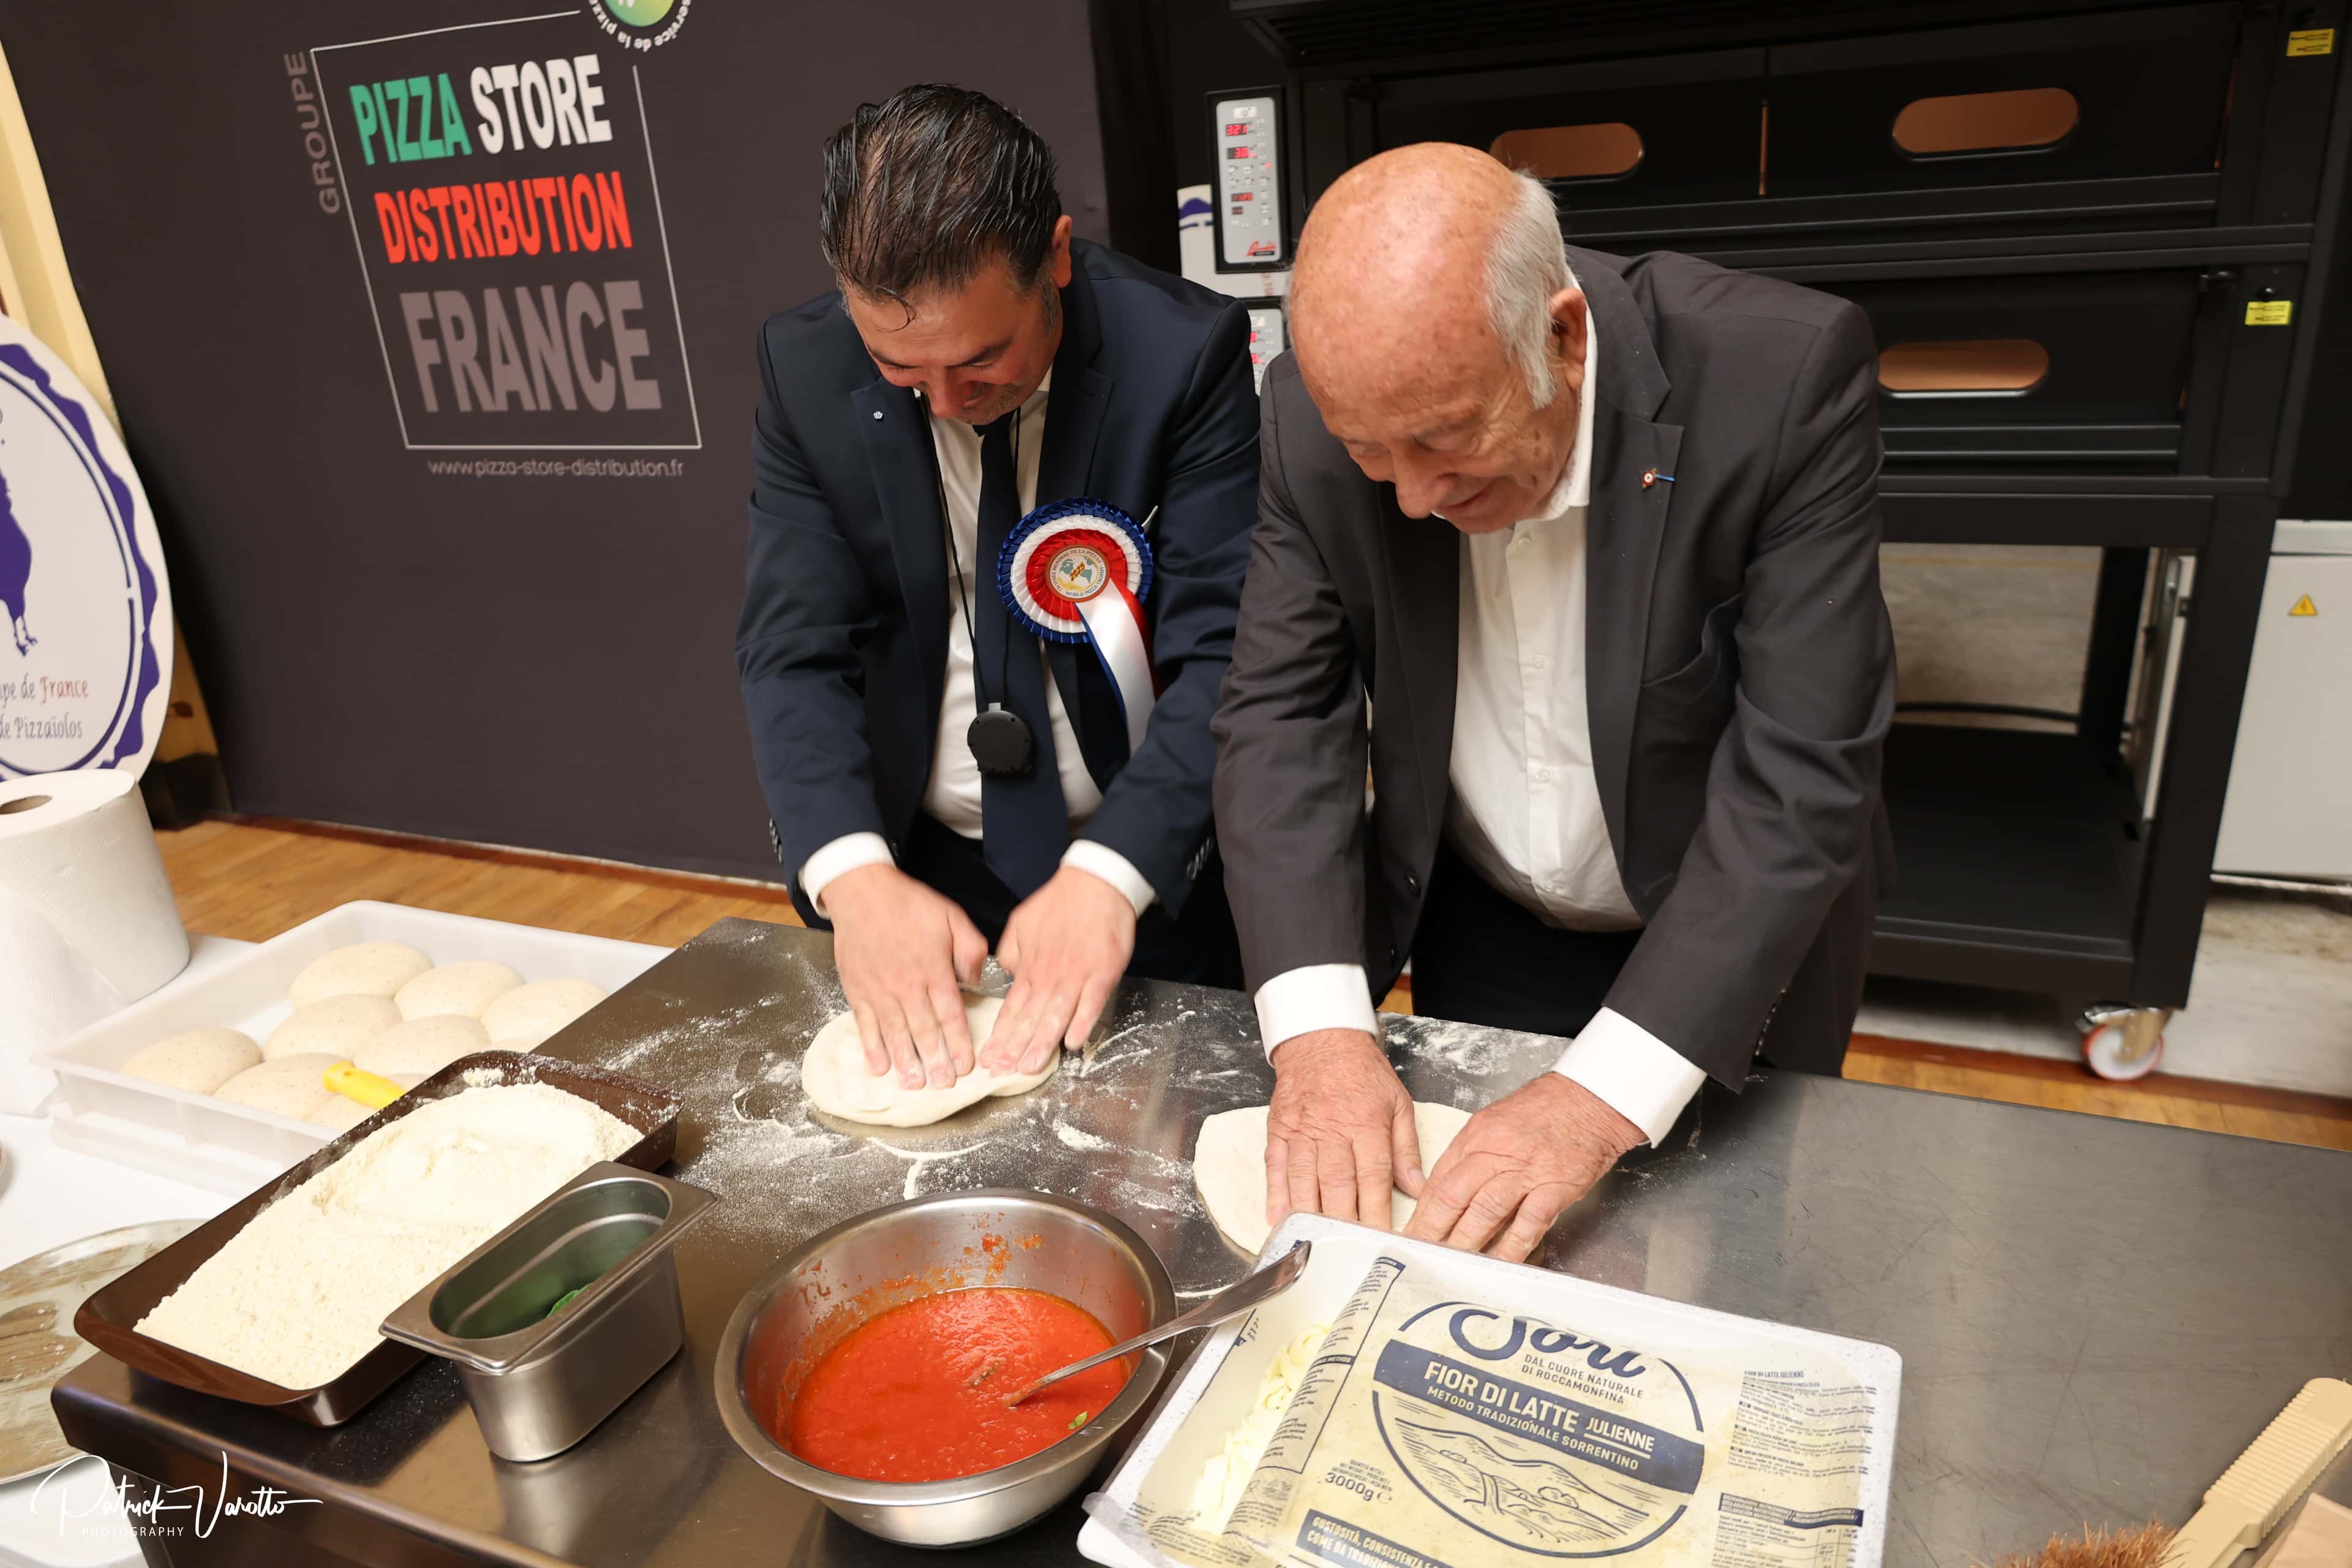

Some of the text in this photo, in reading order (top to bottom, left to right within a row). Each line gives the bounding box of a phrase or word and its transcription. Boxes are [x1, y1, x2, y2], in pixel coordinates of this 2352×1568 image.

[617, 32, 631, 49] la
[633, 38, 652, 52] de
[350, 54, 613, 165] PIZZA STORE
[284, 51, 341, 214] GROUPE
[374, 171, 632, 264] DISTRIBUTION
[399, 281, 662, 412] FRANCE
[428, 458, 684, 478] www.pizza-store-distribution.fr
[1069, 562, 1085, 581] 2025
[1085, 585, 1098, 595] PIZZA
[21, 672, 36, 699] de
[40, 676, 89, 704] France
[14, 711, 83, 739] Pizzaïolos
[1521, 1365, 1625, 1404] DI ROCCAMONFINA
[1525, 1354, 1644, 1398] DAL CUORE NATURALE
[1423, 1360, 1656, 1453] FIOR DI LATTE JULIENNE
[1427, 1385, 1640, 1471] METODO TRADIZIONALE SORRENTINO
[1325, 1472, 1374, 1501] 3000g
[1306, 1529, 1334, 1550] COME
